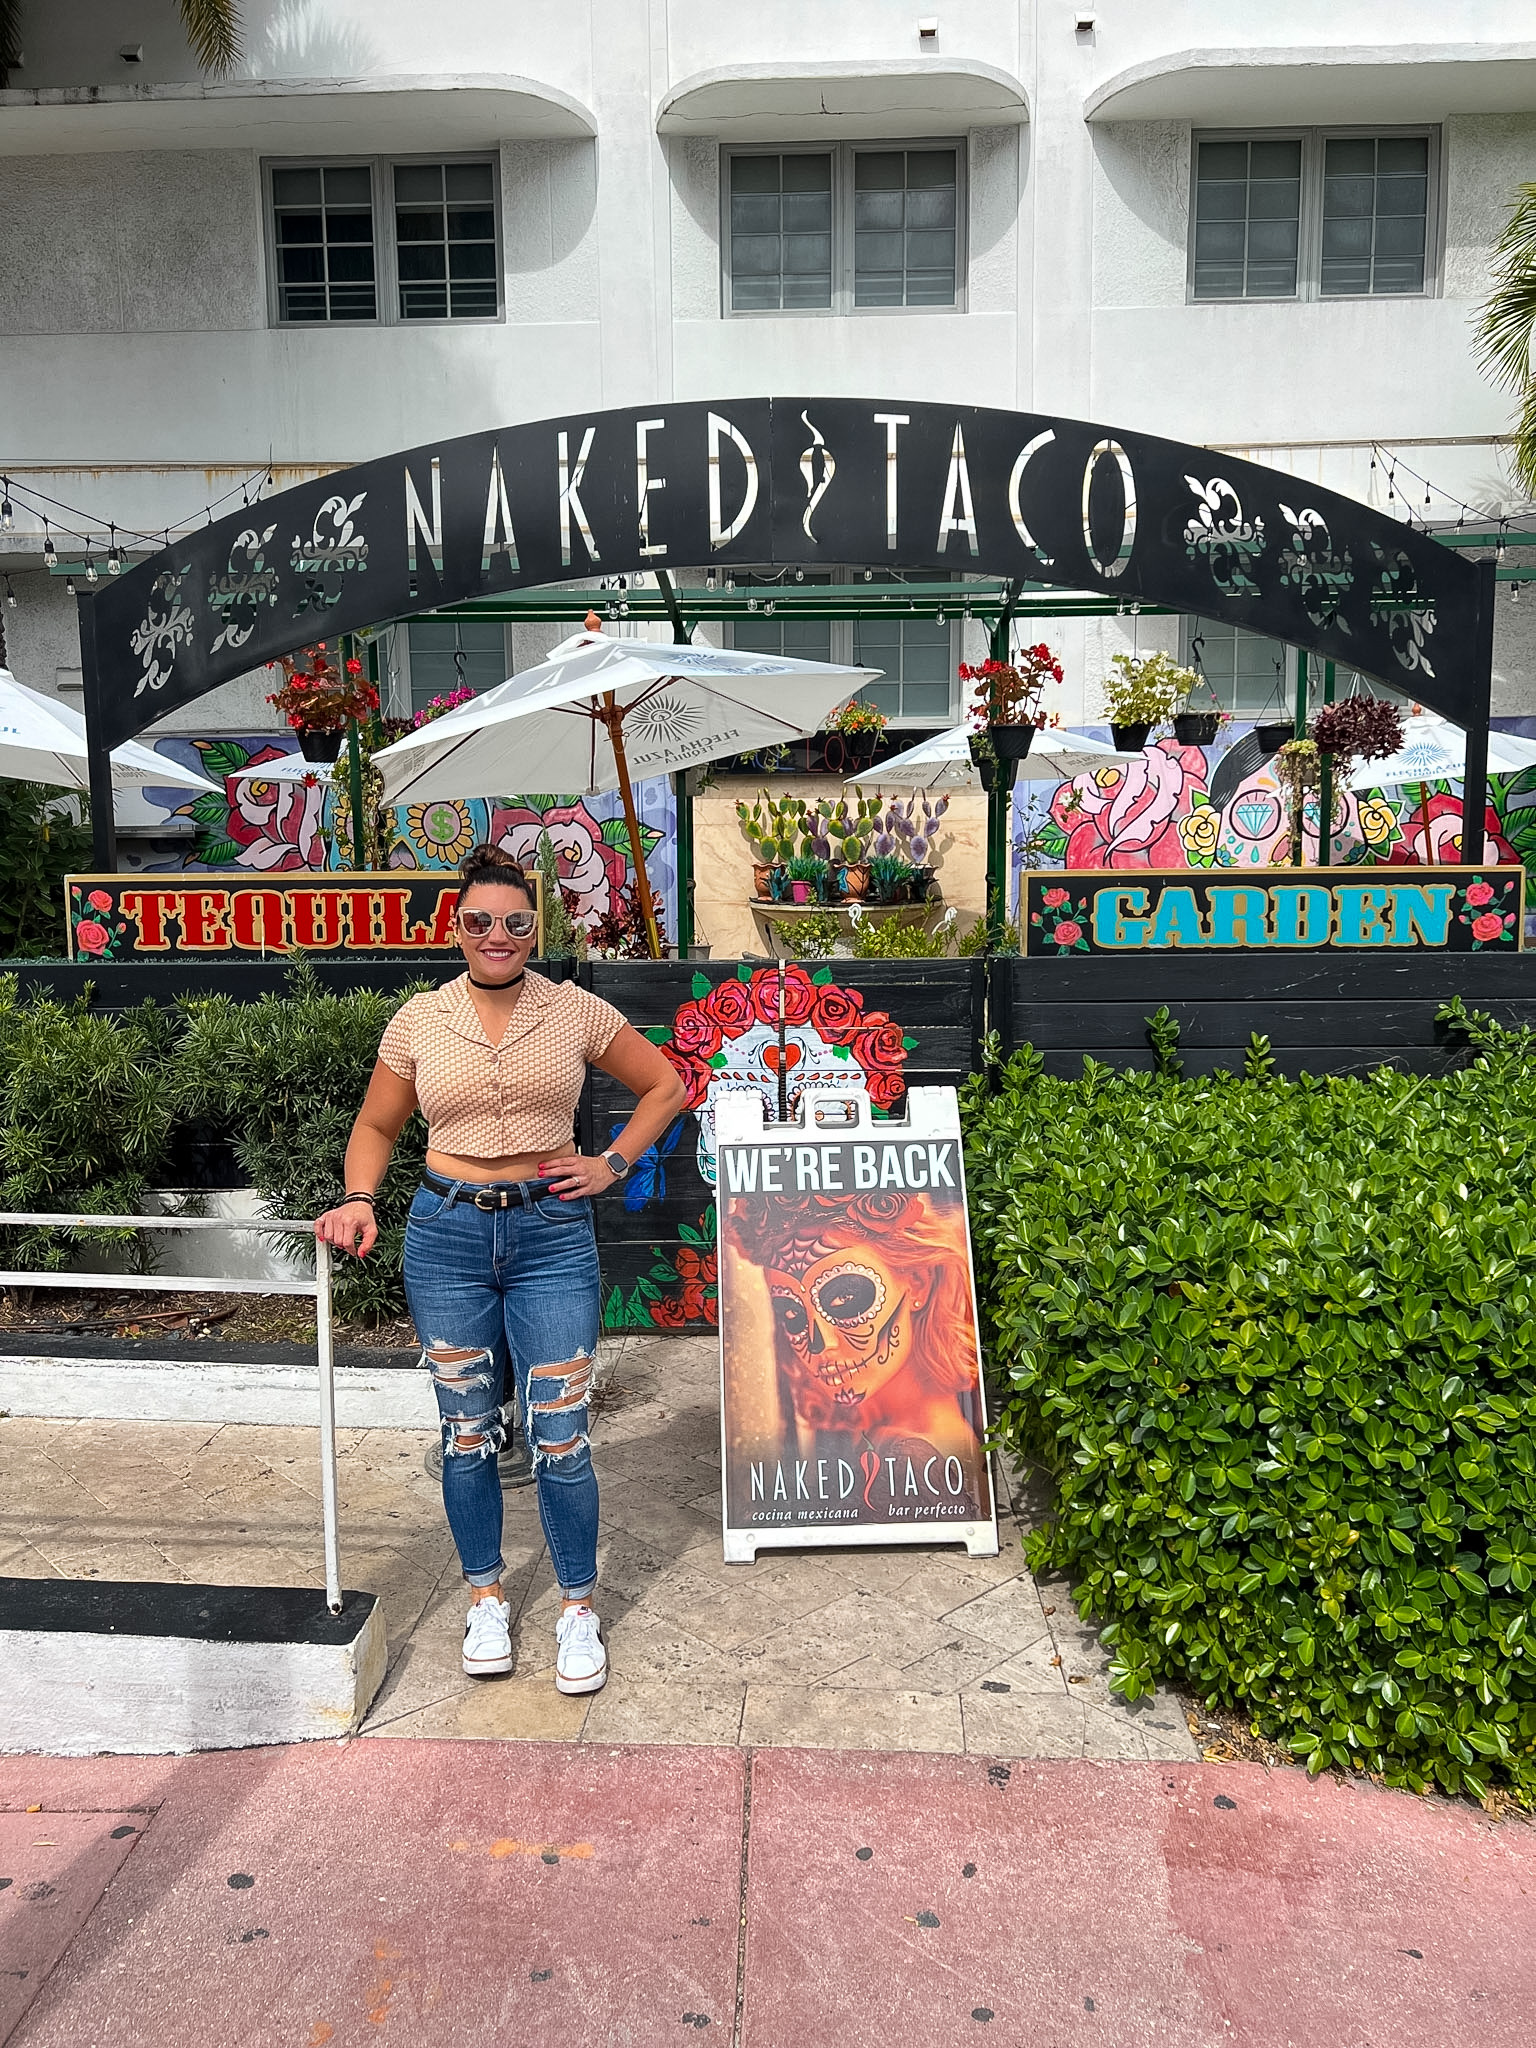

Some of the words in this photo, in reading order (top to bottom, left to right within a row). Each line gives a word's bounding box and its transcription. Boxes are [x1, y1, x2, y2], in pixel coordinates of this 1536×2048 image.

[405, 411, 759, 597] NAKED
[873, 413, 1137, 578] TACO
[1091, 885, 1456, 949] GARDEN
[724, 1146, 844, 1193] WE'RE
[853, 1143, 956, 1190] BACK
[751, 1457, 855, 1501] NAKED
[885, 1455, 963, 1497] TACO
[752, 1508, 792, 1521] cocina
[797, 1507, 859, 1520] mexicana
[888, 1504, 911, 1517] bar
[914, 1502, 966, 1519] perfecto
